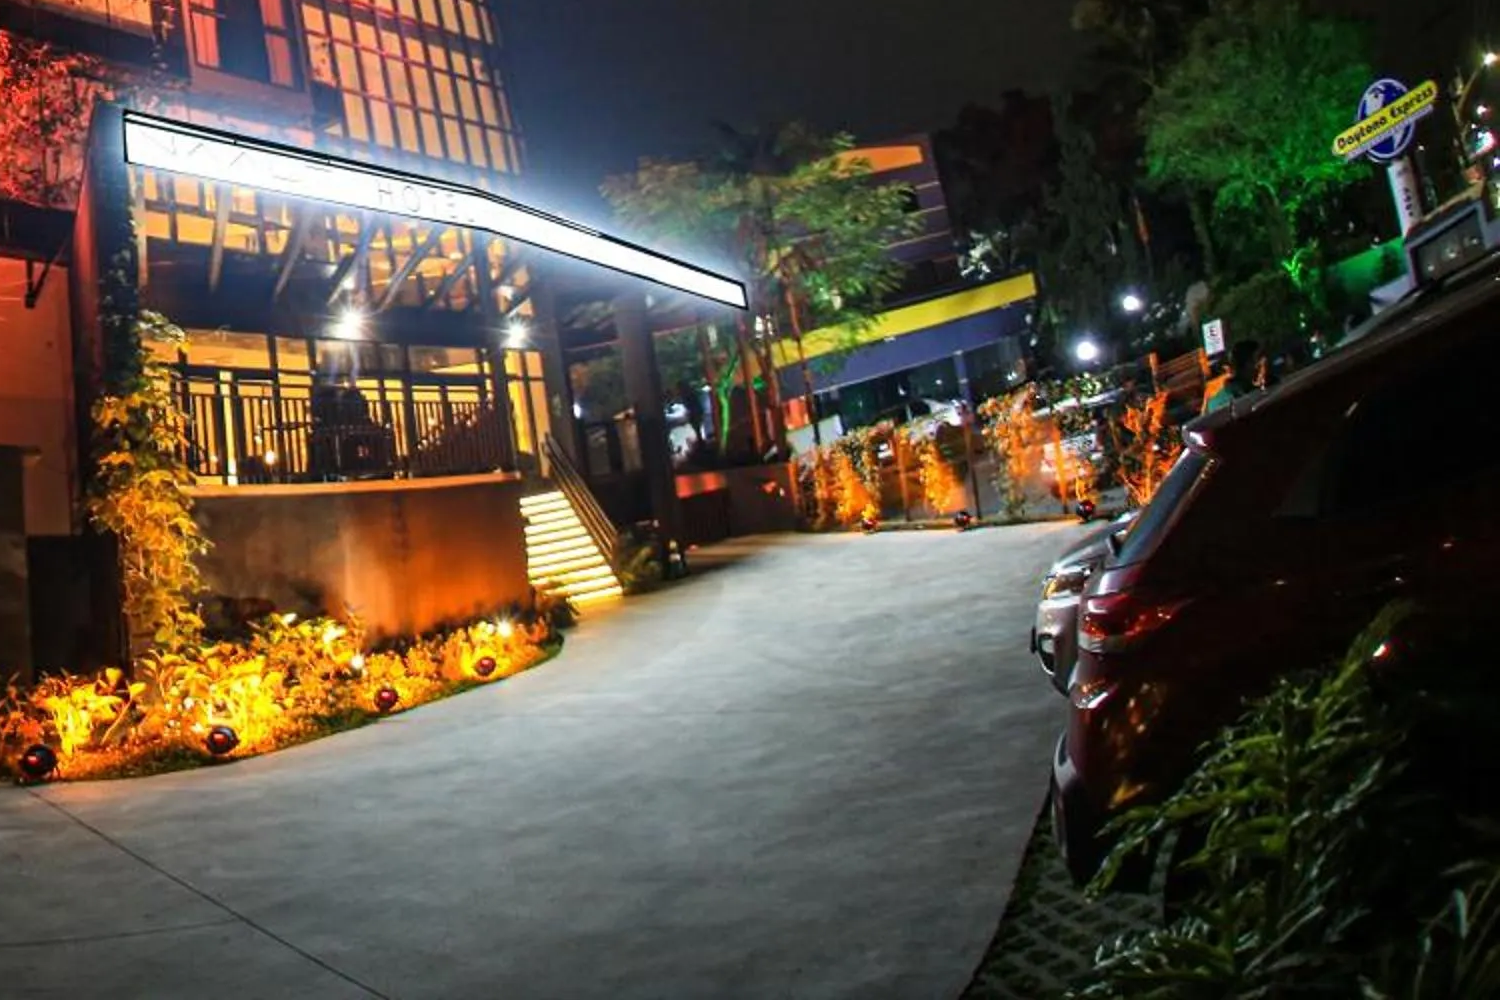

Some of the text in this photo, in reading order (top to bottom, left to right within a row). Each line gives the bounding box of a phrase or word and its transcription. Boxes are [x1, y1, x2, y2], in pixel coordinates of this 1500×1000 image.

[1336, 85, 1434, 150] Daytona Express
[376, 179, 476, 222] HOTEL
